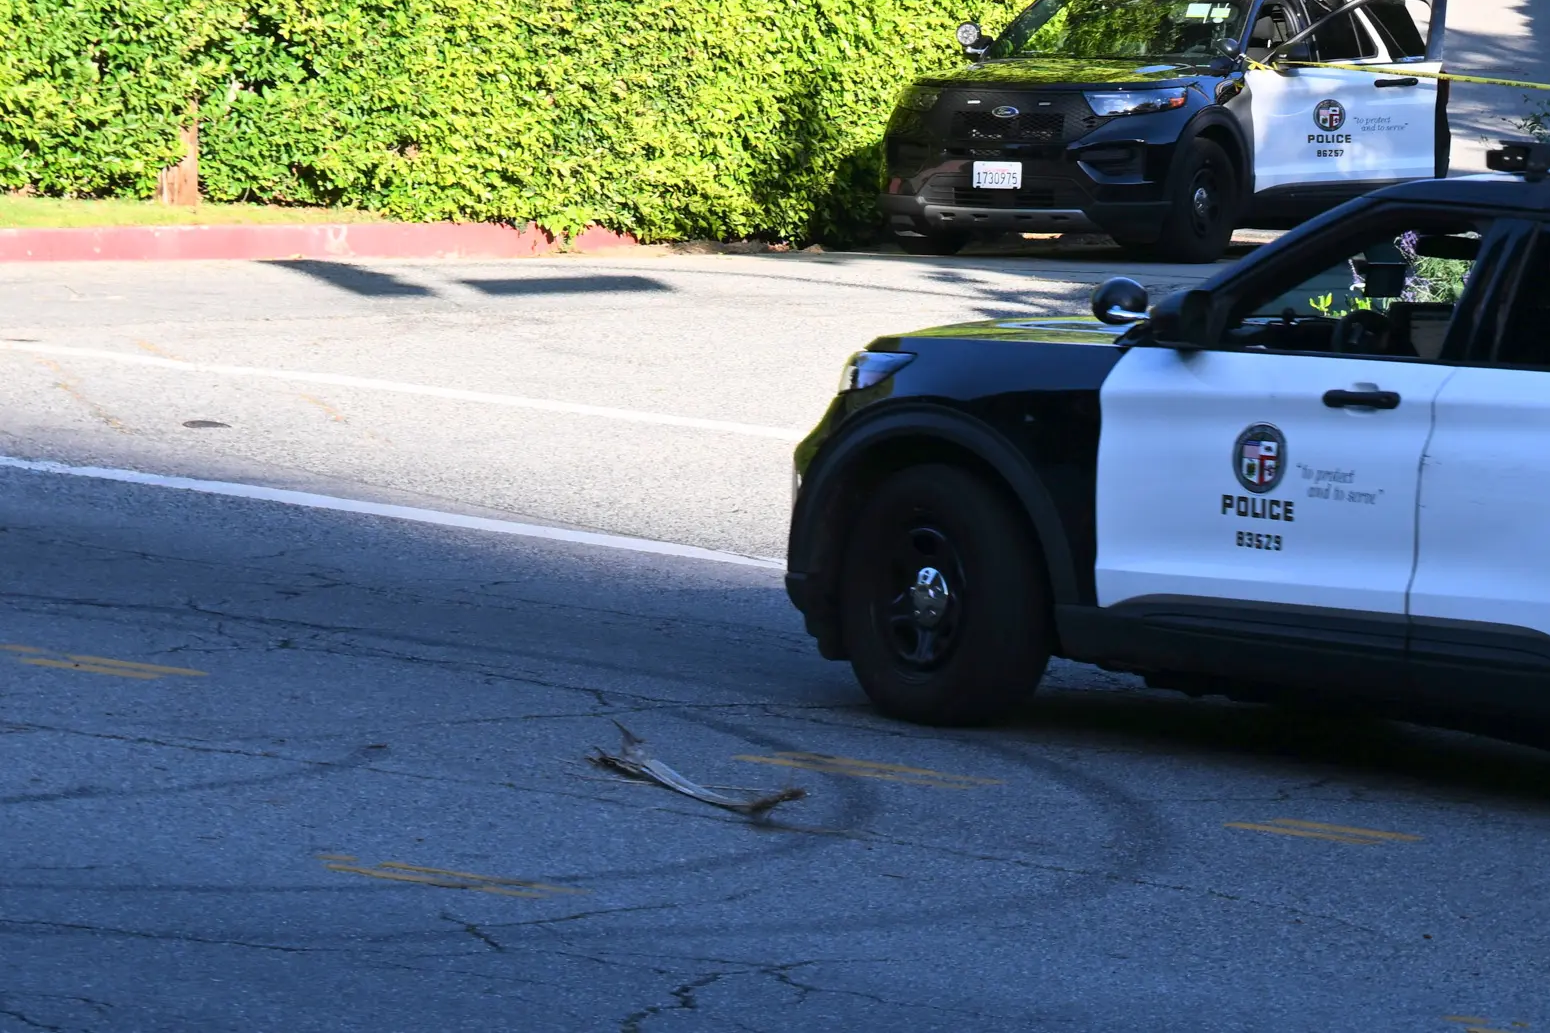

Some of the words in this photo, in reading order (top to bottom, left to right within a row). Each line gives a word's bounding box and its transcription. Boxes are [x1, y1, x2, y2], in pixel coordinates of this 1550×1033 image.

[1365, 116, 1391, 125] protect
[1308, 134, 1352, 144] POLICE
[1317, 149, 1344, 157] 86257
[976, 171, 1018, 185] 1730975
[1314, 470, 1356, 485] protect
[1307, 483, 1331, 499] and
[1332, 486, 1346, 501] to
[1221, 494, 1295, 522] POLICE
[1236, 531, 1283, 551] 83529
